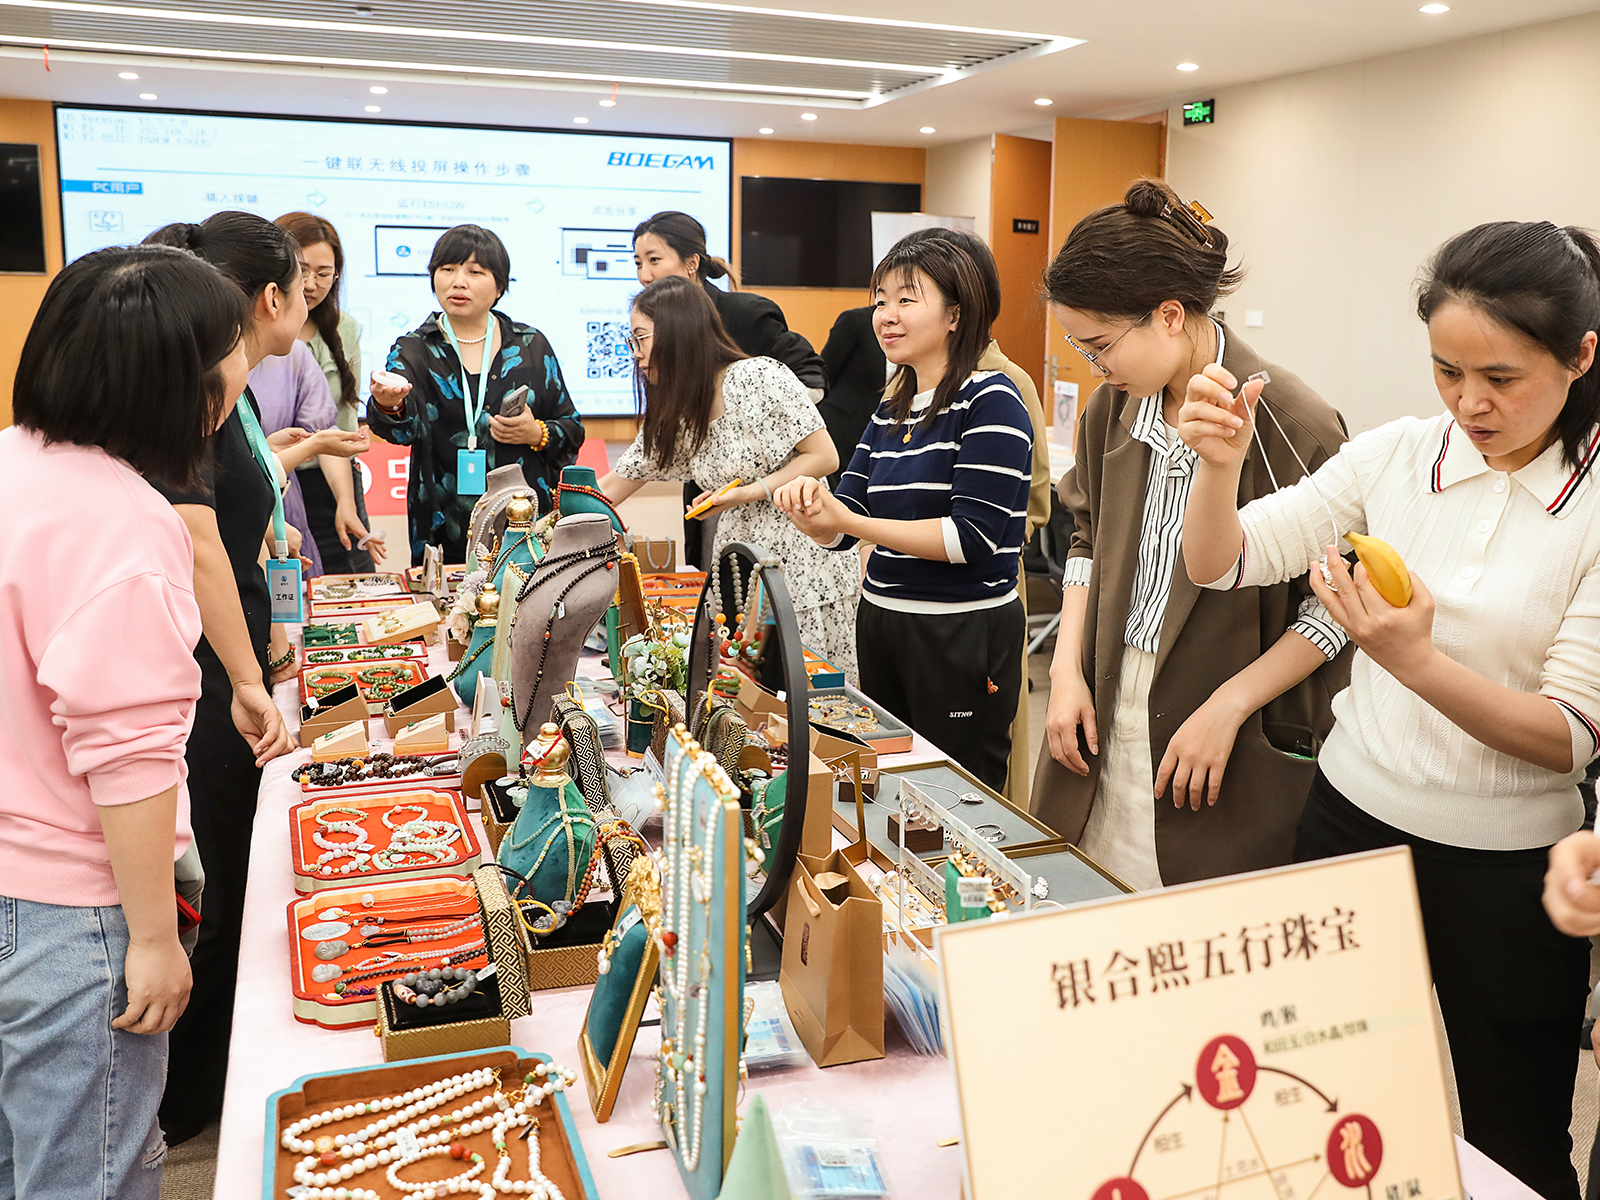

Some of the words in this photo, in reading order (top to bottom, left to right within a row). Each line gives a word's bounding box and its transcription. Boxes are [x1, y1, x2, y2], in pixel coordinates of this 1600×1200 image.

[302, 155, 531, 178] 一键联无线投屏操作步骤
[607, 151, 714, 170] BOEGAM
[92, 181, 140, 193] PC用户
[275, 593, 295, 601] 工作证
[1049, 906, 1362, 1010] 银合熙五行珠宝
[1210, 1042, 1246, 1105] 金
